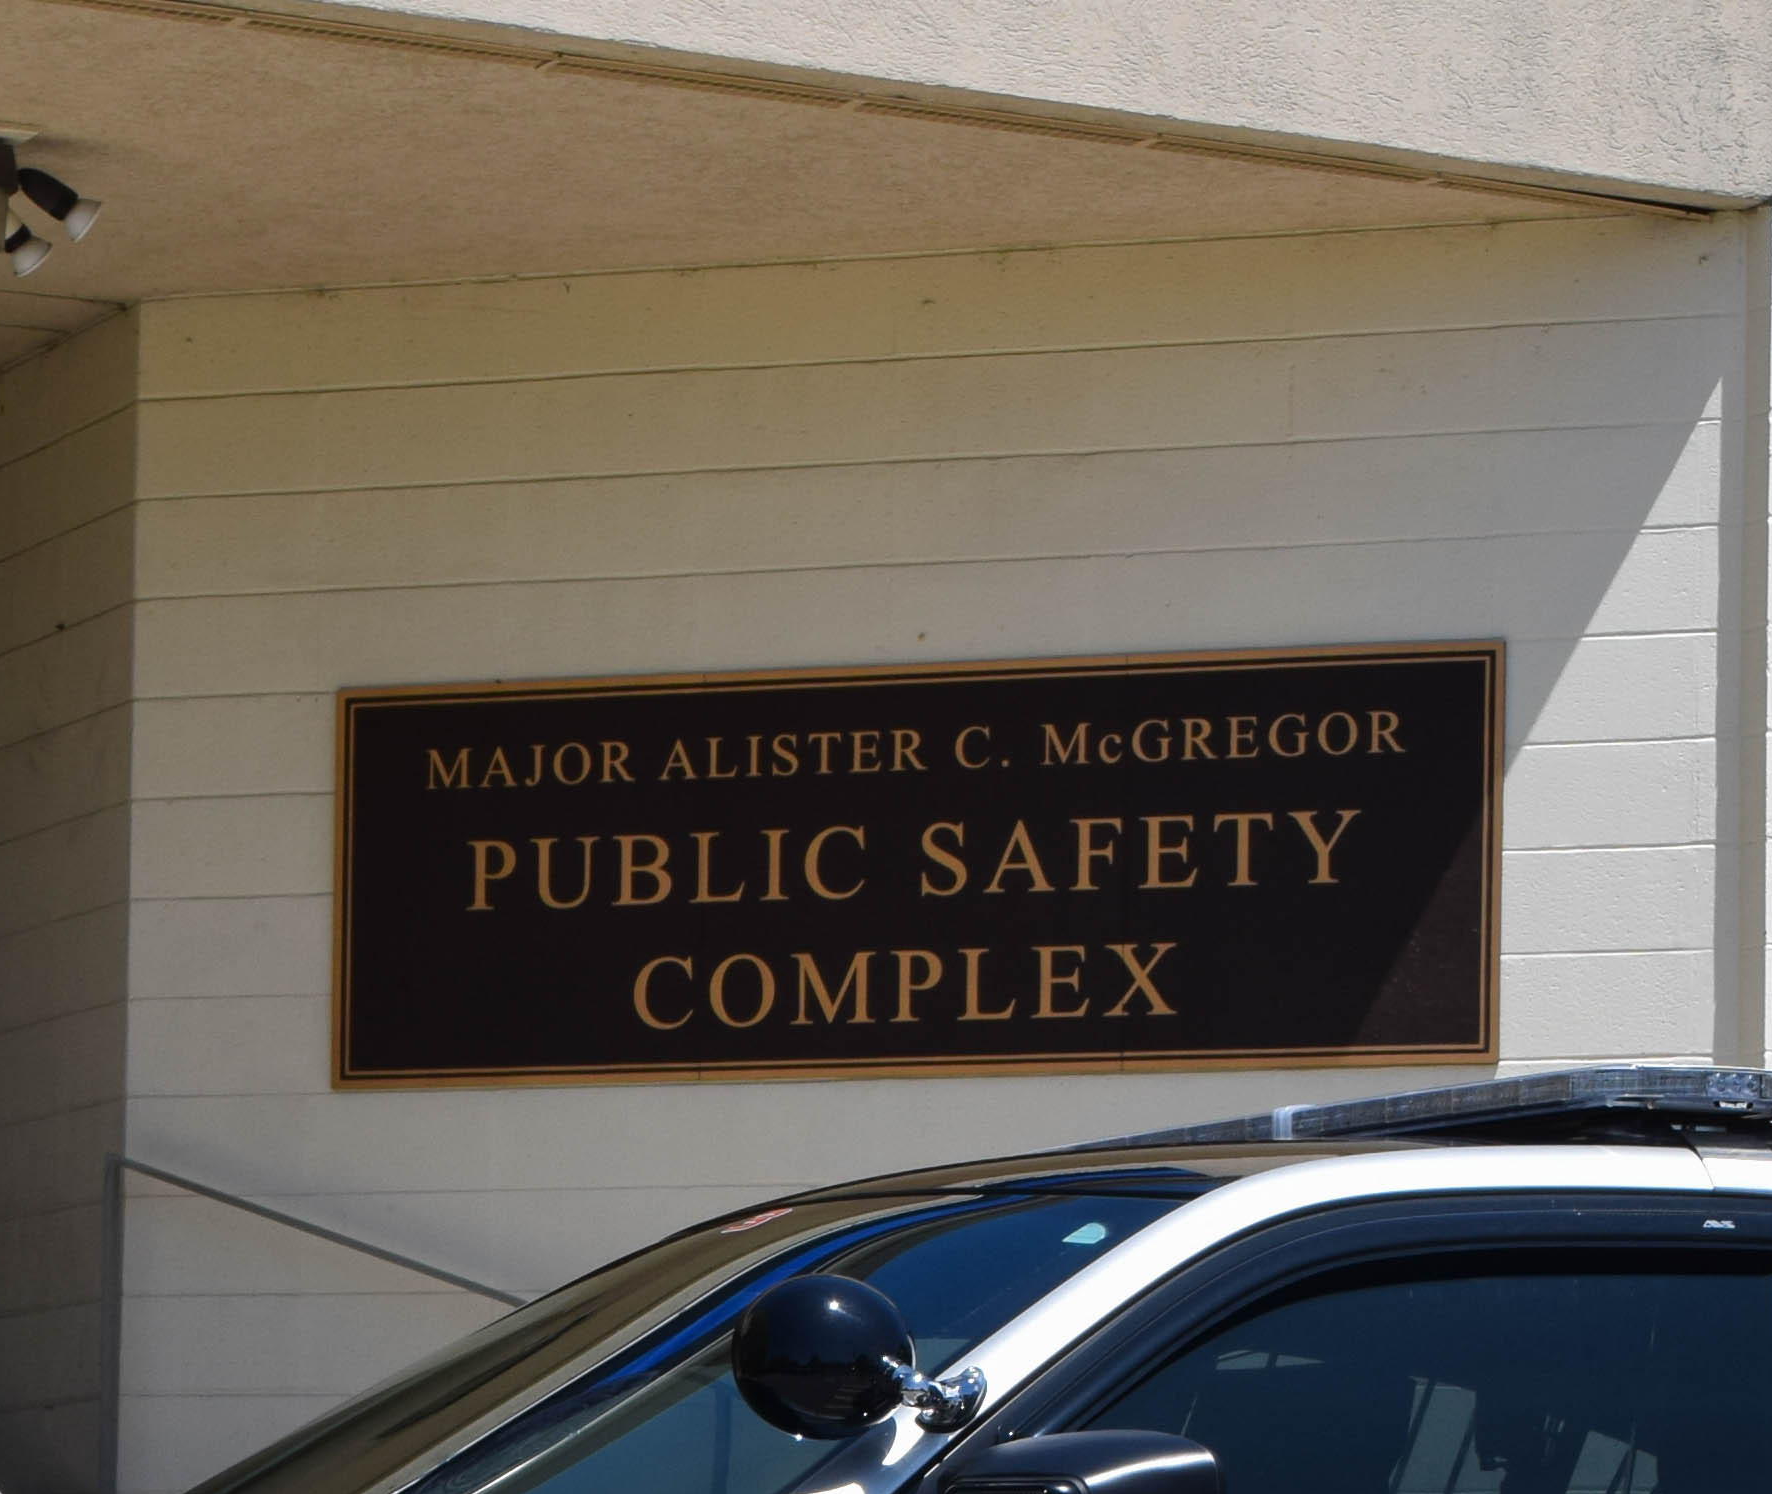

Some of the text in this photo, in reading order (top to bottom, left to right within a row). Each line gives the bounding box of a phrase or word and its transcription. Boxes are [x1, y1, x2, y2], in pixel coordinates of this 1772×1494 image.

[428, 709, 1404, 790] MAJOR ALISTER C. McGREGOR
[467, 808, 1361, 911] PUBLIC SAFETY
[632, 940, 1178, 1031] COMPLEX
